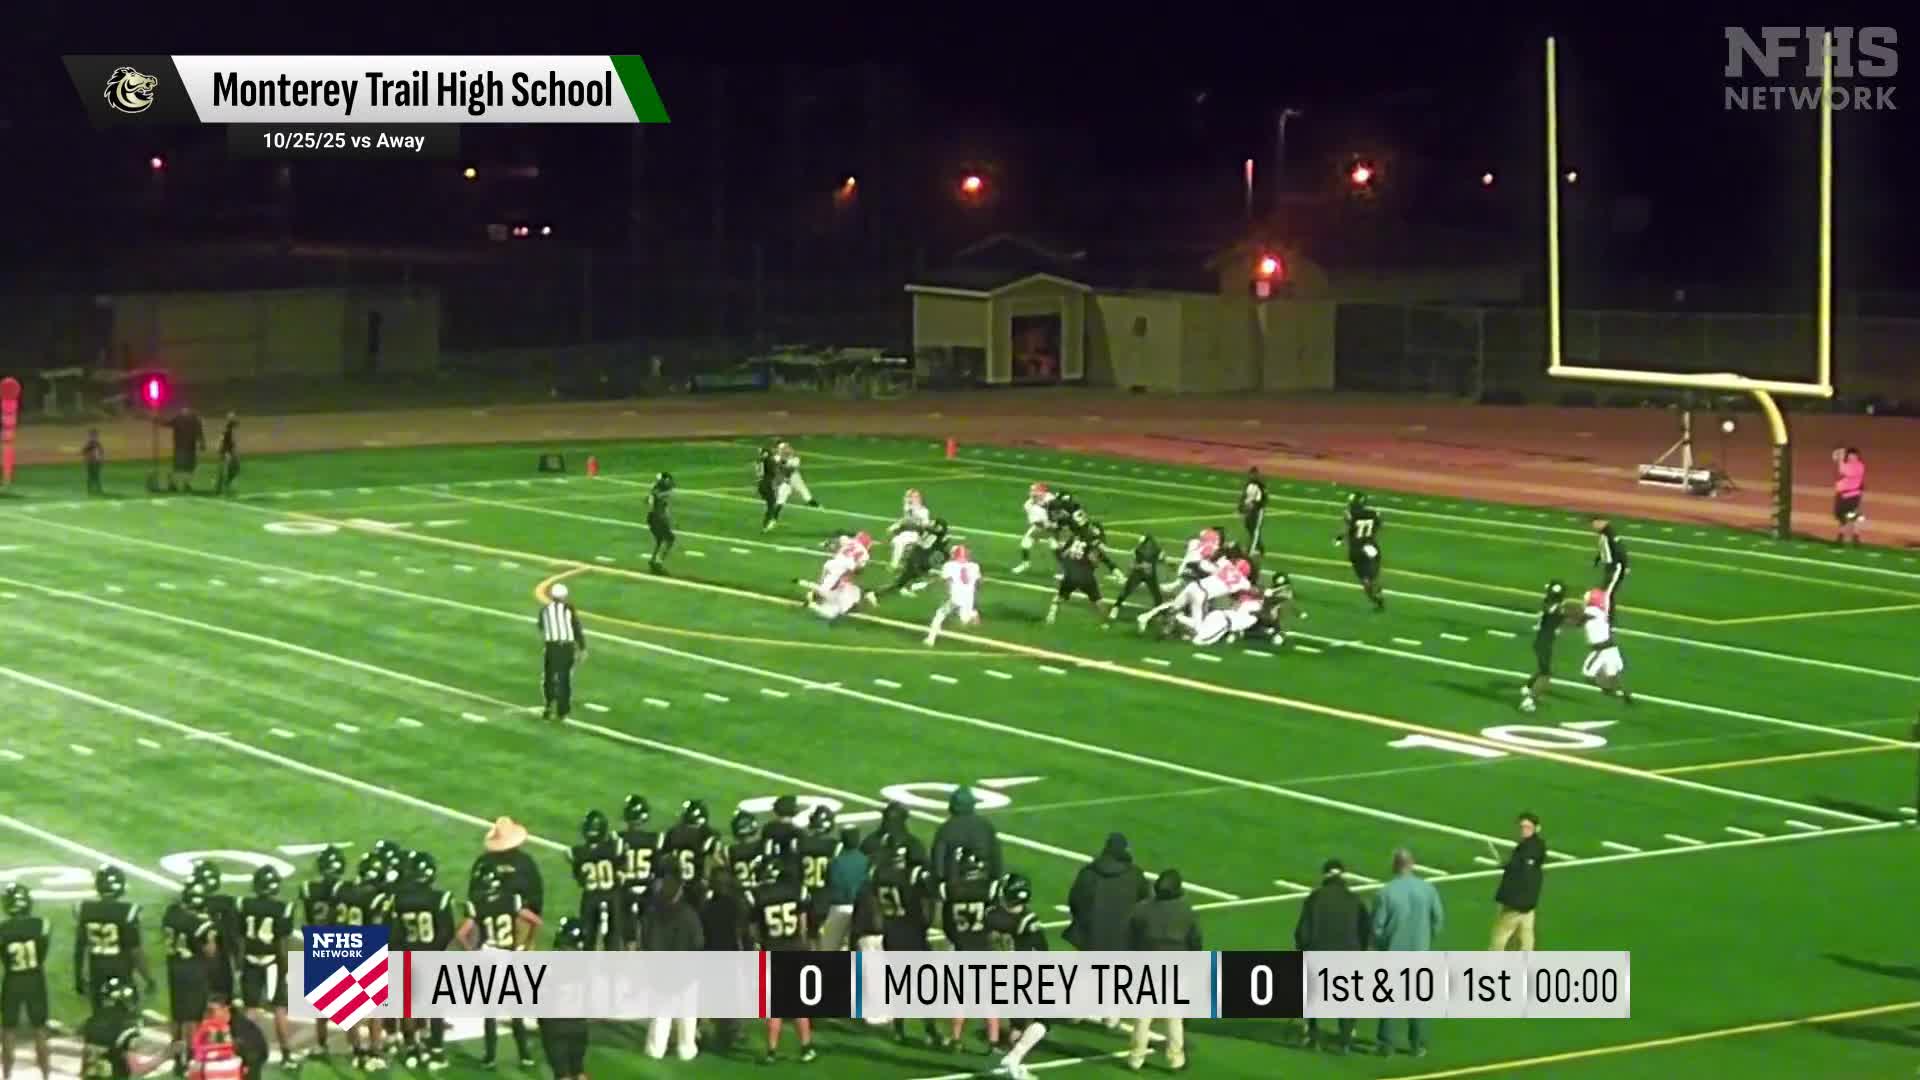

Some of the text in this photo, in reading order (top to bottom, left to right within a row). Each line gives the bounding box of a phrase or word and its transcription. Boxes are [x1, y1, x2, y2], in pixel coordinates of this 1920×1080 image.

[1387, 724, 1608, 757] 10
[625, 848, 653, 879] 15
[245, 915, 275, 944] 14
[483, 912, 514, 946] 12
[763, 901, 798, 937] 55
[953, 902, 985, 932] 57
[87, 922, 120, 955] 52
